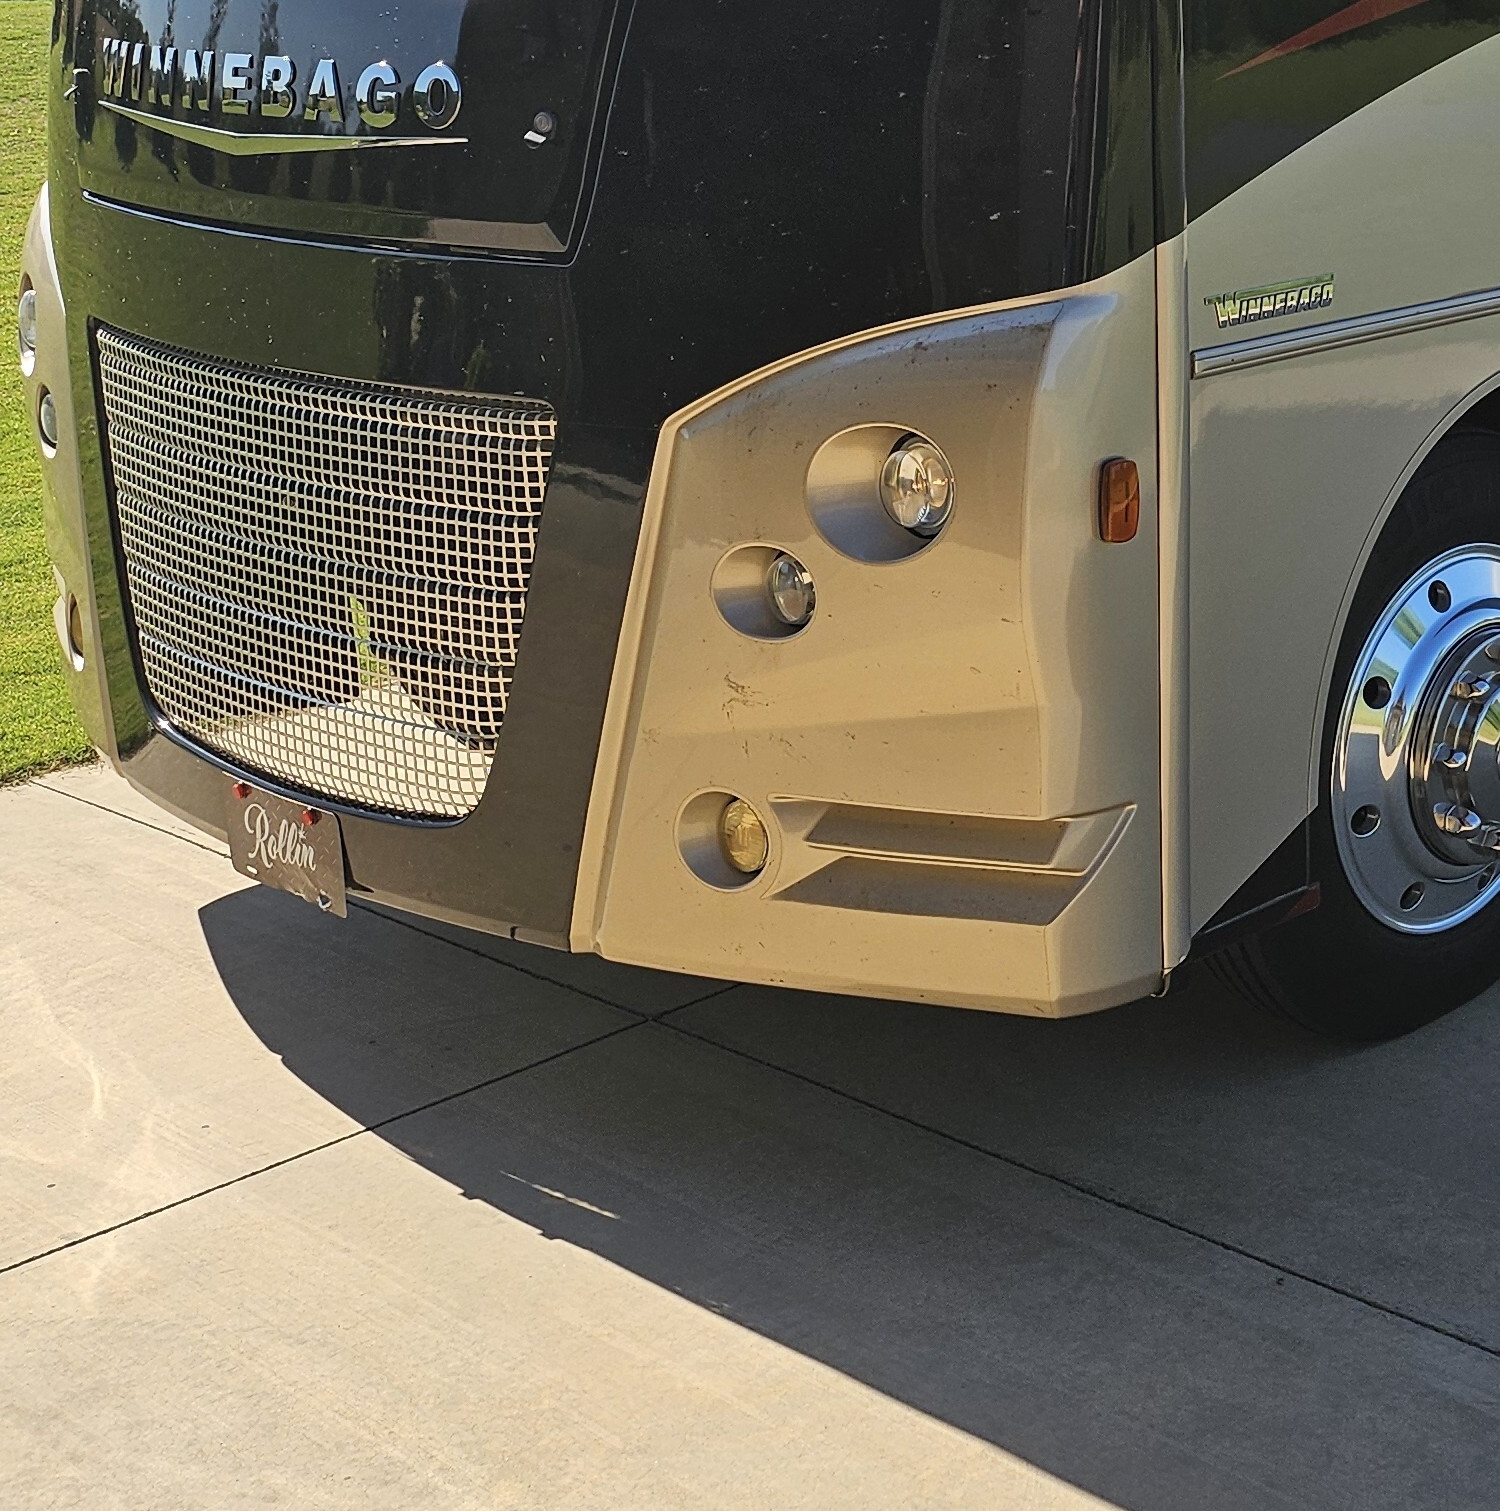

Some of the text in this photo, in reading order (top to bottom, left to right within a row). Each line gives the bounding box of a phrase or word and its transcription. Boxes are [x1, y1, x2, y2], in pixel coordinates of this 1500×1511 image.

[102, 37, 462, 129] WINNEBAGO
[1204, 274, 1334, 328] WINNEBAGO
[244, 803, 317, 871] Rollin
